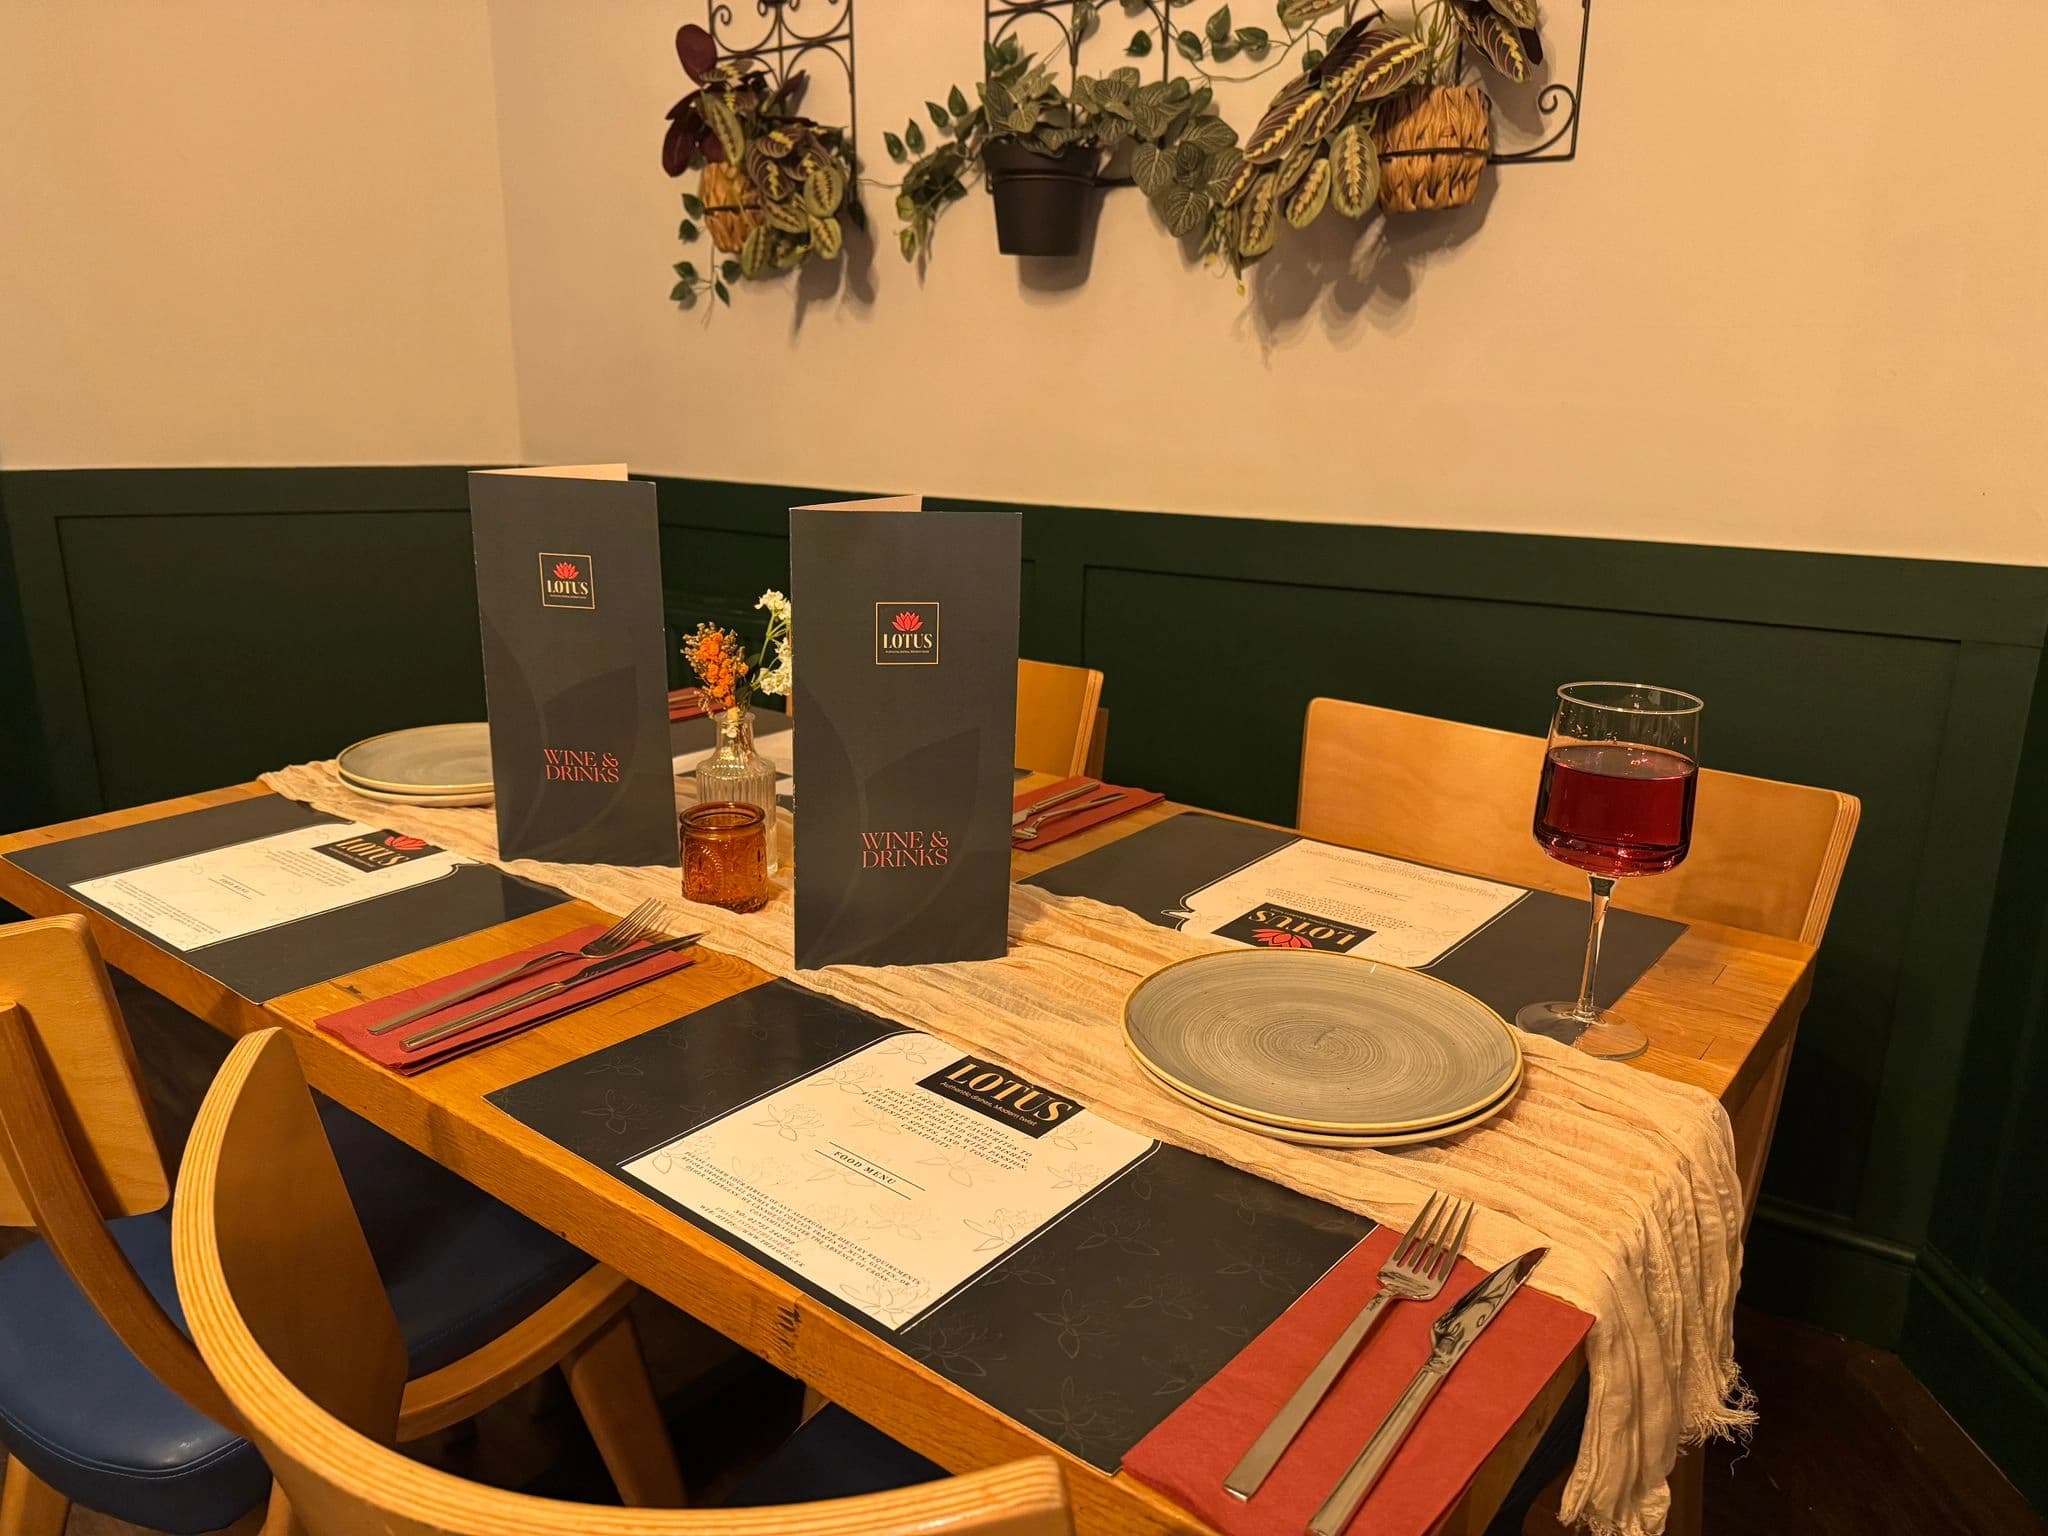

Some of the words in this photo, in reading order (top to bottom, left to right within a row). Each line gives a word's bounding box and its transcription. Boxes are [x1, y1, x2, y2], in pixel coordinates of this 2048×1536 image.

[547, 580, 589, 595] LOTUS
[883, 633, 933, 649] LOTUS
[544, 749, 597, 767] WINE
[602, 752, 619, 768] &
[546, 765, 620, 783] DRINKS
[335, 838, 411, 866] LOTUS
[861, 831, 923, 849] WINE
[930, 830, 949, 848] &
[863, 848, 948, 868] DRINKS
[1248, 910, 1356, 945] LOTUS
[940, 1081, 971, 1099] Authentic
[993, 1104, 1019, 1120] Modern
[945, 1063, 1072, 1122] LOTUS
[860, 1091, 887, 1103] EVERY
[887, 1103, 913, 1116] PLATE
[922, 1119, 962, 1139] CRAFTED
[961, 1138, 988, 1151] WITH
[872, 1089, 909, 1106] ELEGANT
[908, 1106, 947, 1124] SEAFOOD
[947, 1124, 966, 1133] AND
[965, 1132, 993, 1146] GRILL
[883, 1087, 908, 1099] FROM
[906, 1098, 938, 1113] STREET
[936, 1112, 965, 1125] STYLE
[964, 1124, 1019, 1150] FAVOURITES
[916, 1095, 943, 1108] FRESH
[943, 1108, 970, 1120] TASTE
[982, 1126, 1010, 1139] INDIA
[863, 1099, 908, 1120] AUTHENTIC
[941, 1135, 960, 1145] AND
[967, 1148, 999, 1164] TOUCH
[999, 1163, 1014, 1171] OF
[832, 1150, 864, 1167] FOOD
[862, 1166, 897, 1184] MENU
